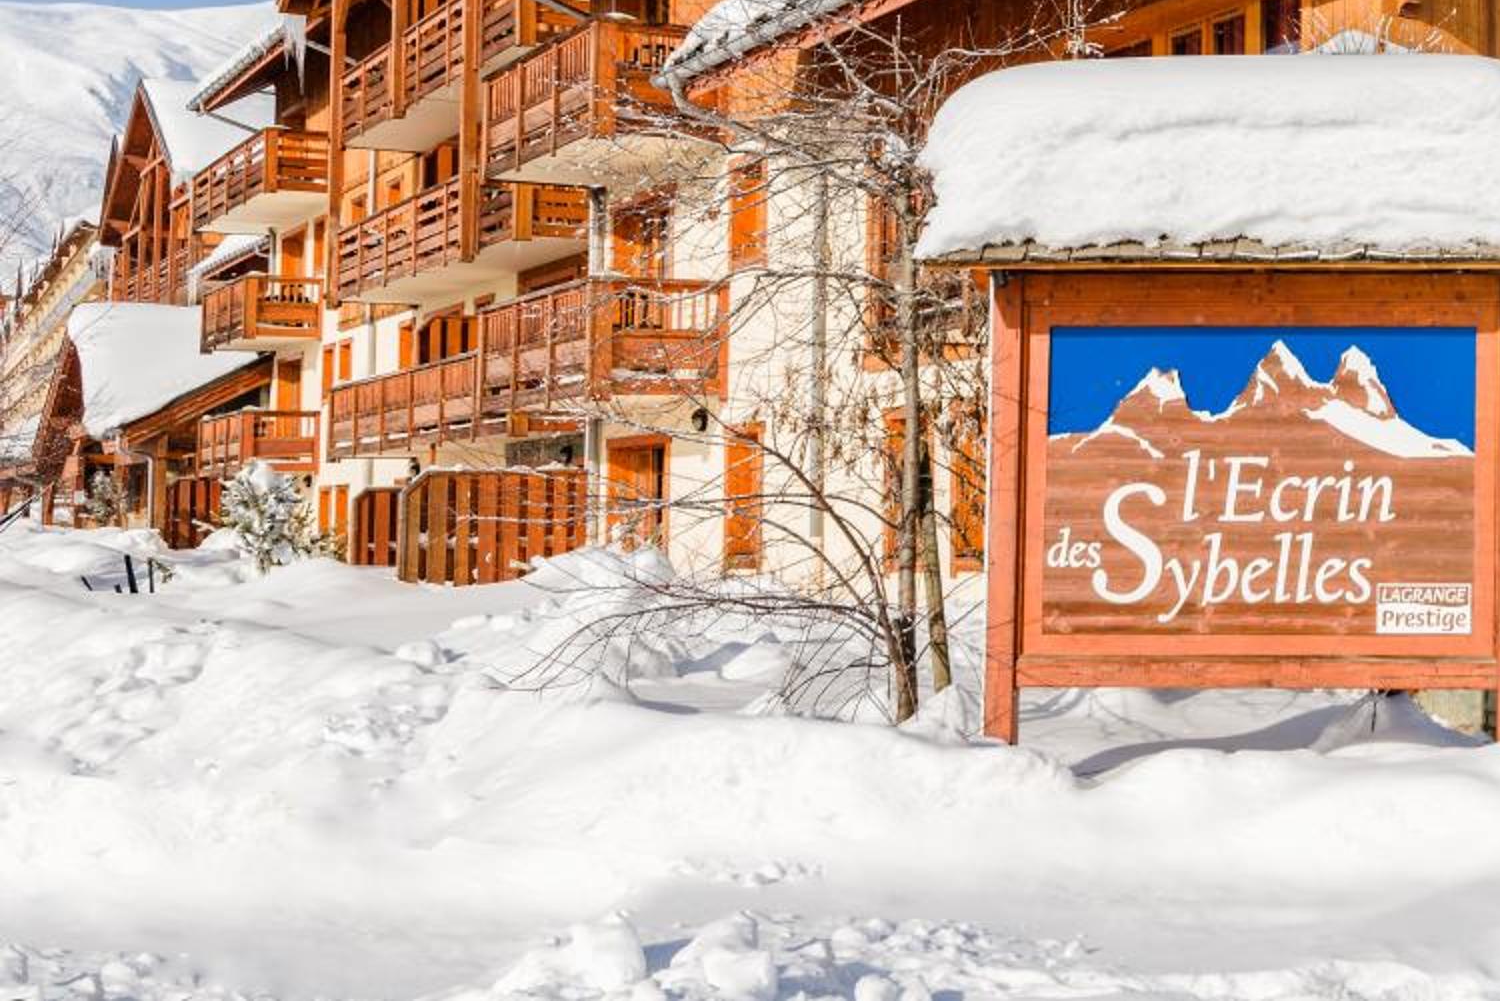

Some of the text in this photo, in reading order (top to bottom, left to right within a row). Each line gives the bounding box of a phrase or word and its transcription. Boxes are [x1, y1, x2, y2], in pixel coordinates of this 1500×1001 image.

[1182, 450, 1396, 523] l'Ecrin
[1047, 482, 1372, 624] des Sybelles
[1381, 587, 1467, 603] LAGRANGE
[1382, 609, 1467, 631] Prestige
